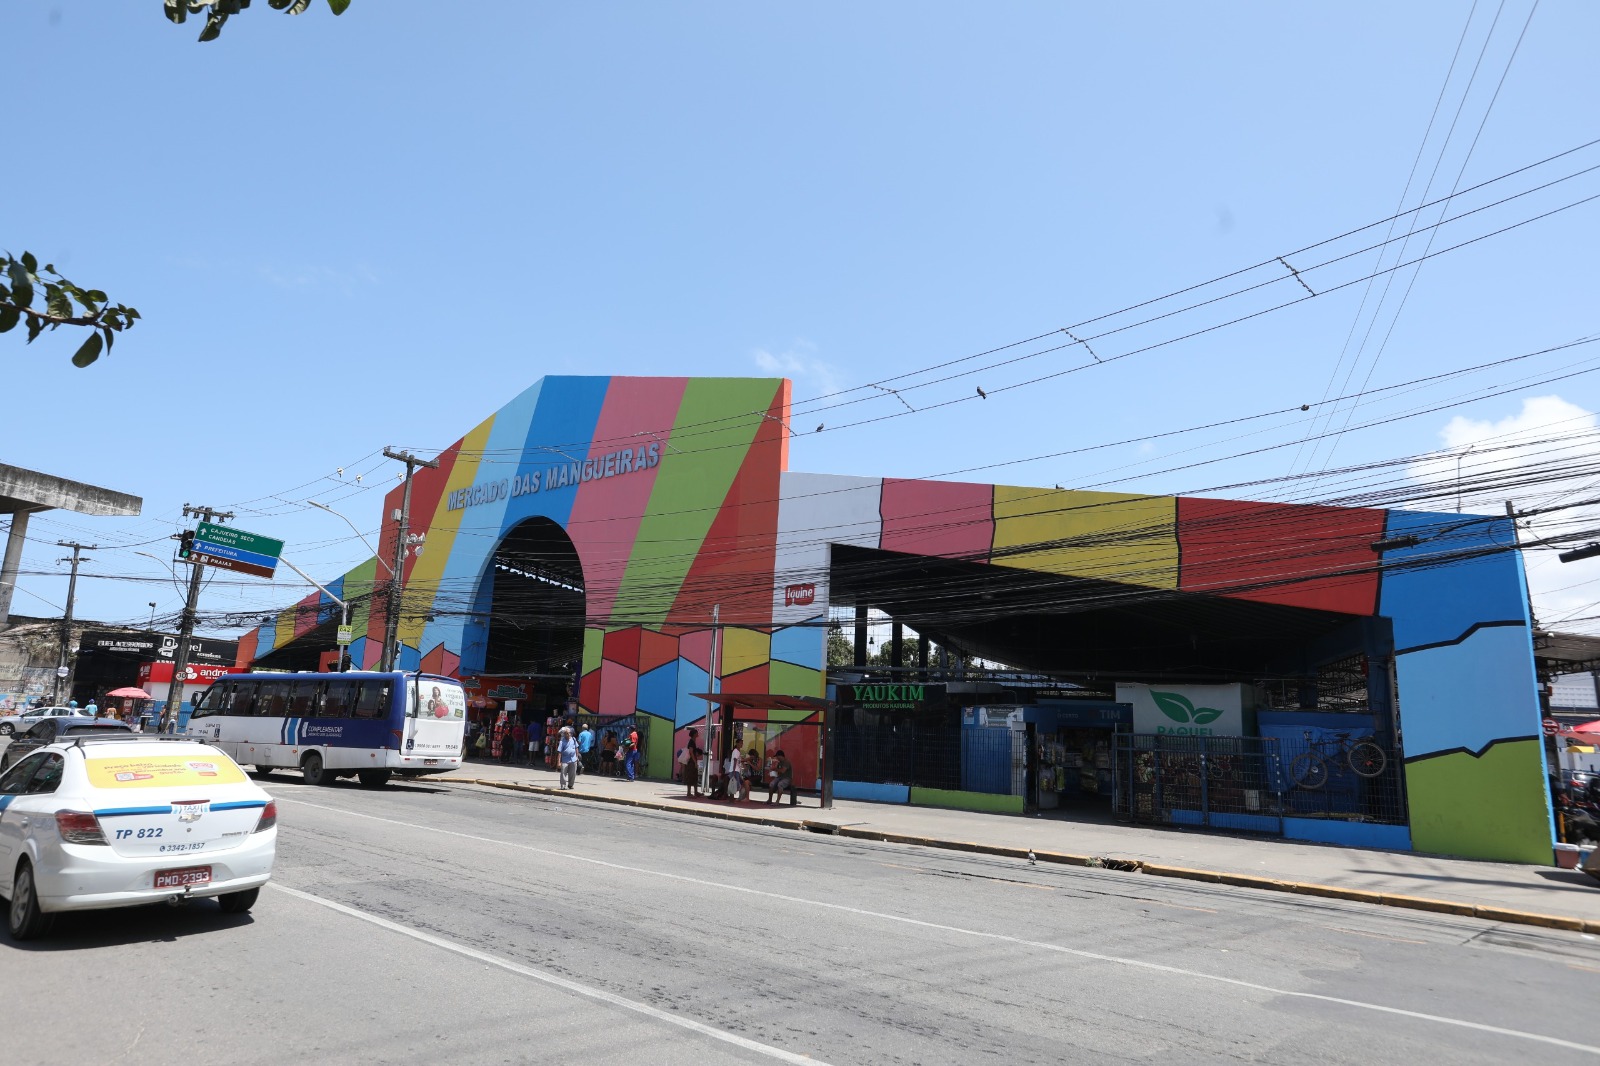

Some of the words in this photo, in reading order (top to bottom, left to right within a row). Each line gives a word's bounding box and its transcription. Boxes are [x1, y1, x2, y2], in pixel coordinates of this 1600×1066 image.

[446, 479, 509, 512] MERCADO
[511, 471, 541, 498] DAS
[545, 442, 660, 491] MANGUEIRAS
[208, 535, 237, 545] CANDEIAS
[210, 528, 238, 538] CAJUEIRO
[240, 535, 255, 543] SECO
[204, 545, 238, 557] PREFEITURA
[210, 558, 233, 567] PRAIAS
[852, 685, 926, 701] YAUKIM
[1100, 709, 1121, 720] TIM
[115, 829, 133, 840] TP
[136, 827, 164, 838] 822
[166, 842, 205, 852] 3342-1857
